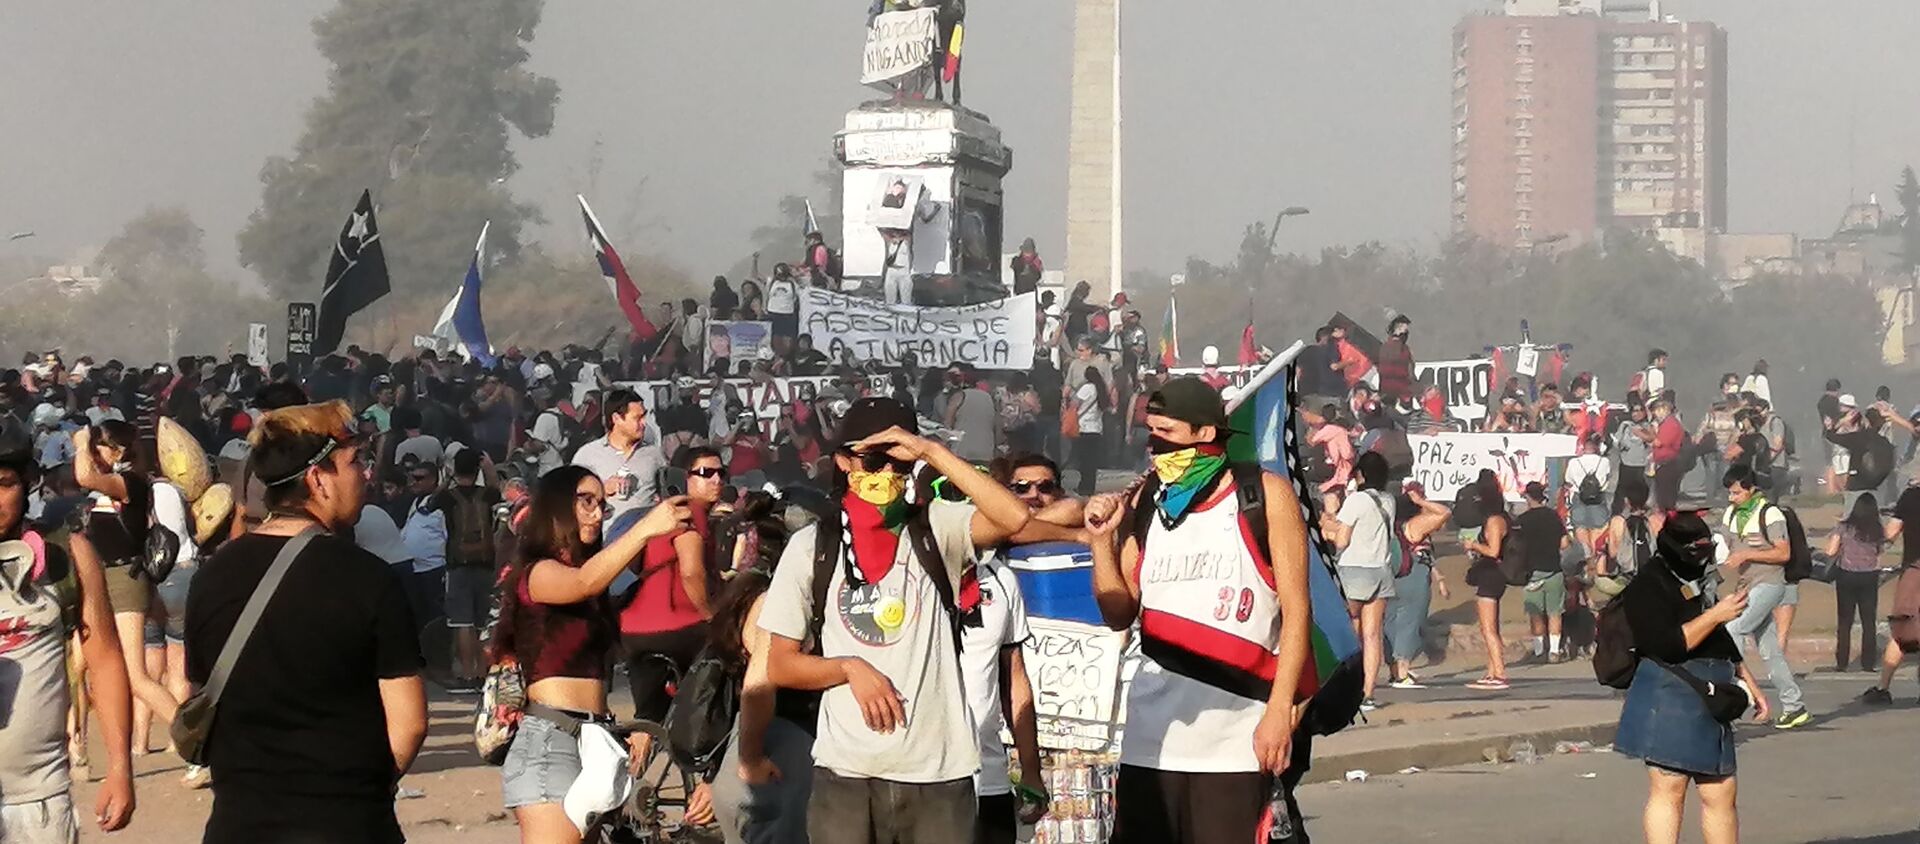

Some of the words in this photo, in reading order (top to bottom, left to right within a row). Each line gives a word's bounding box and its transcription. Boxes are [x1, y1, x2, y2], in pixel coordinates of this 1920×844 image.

[808, 308, 961, 334] ASESINOS
[973, 317, 1009, 337] DE
[1418, 440, 1453, 464] PAZ
[1147, 551, 1238, 583] BLAZERS
